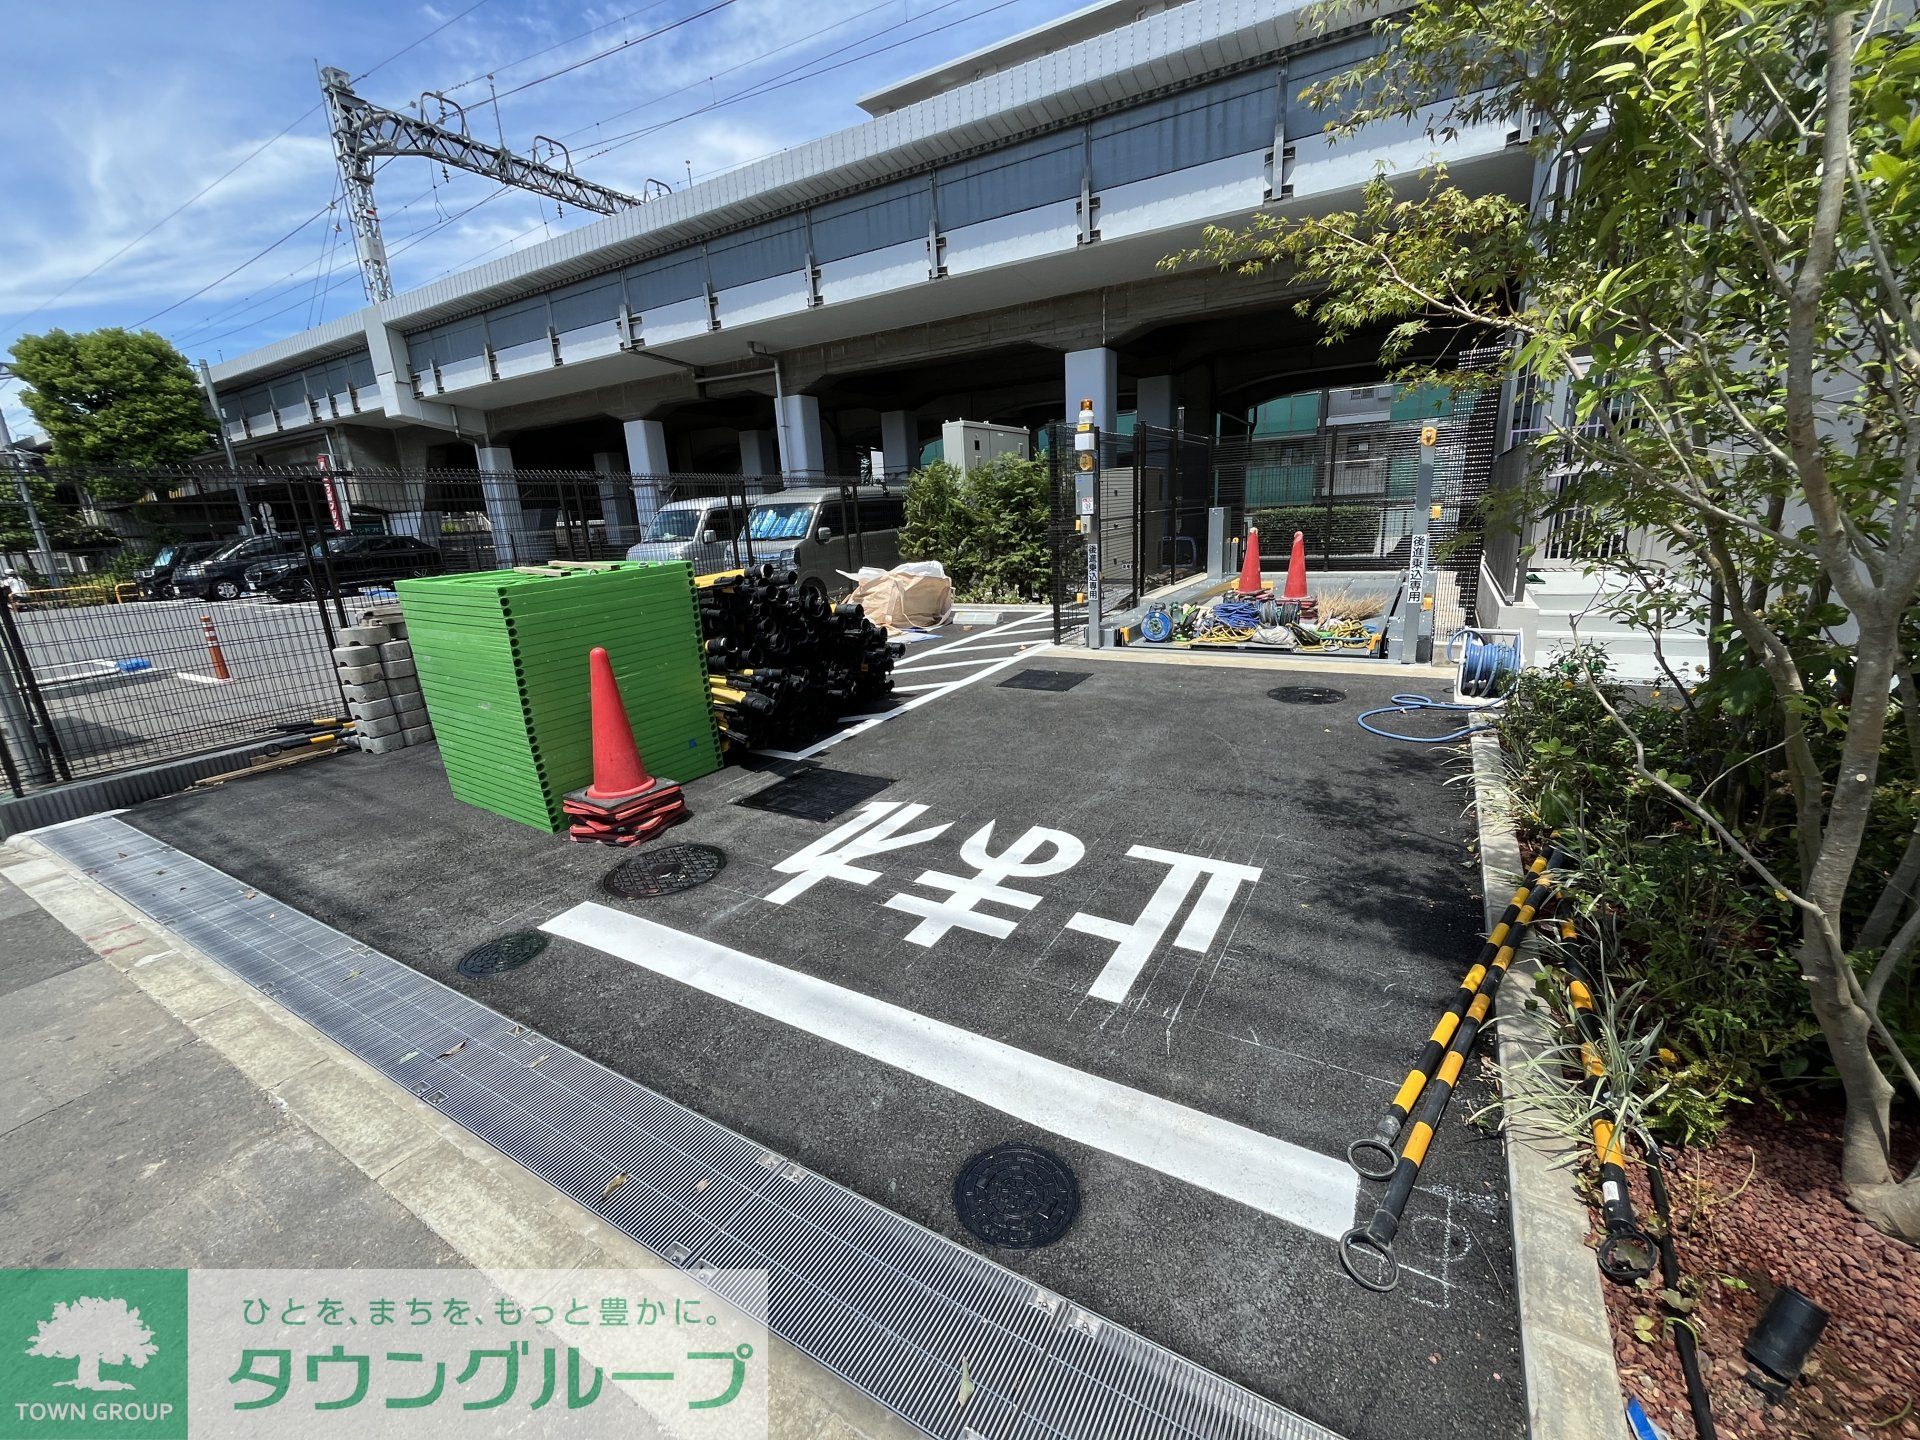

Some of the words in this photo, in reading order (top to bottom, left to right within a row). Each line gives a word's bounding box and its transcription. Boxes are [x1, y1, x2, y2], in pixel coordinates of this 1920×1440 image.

[1088, 544, 1099, 601] 後進乗込専用
[1408, 535, 1425, 602] 後進乗込専用
[763, 801, 1263, 1003] 止まれ
